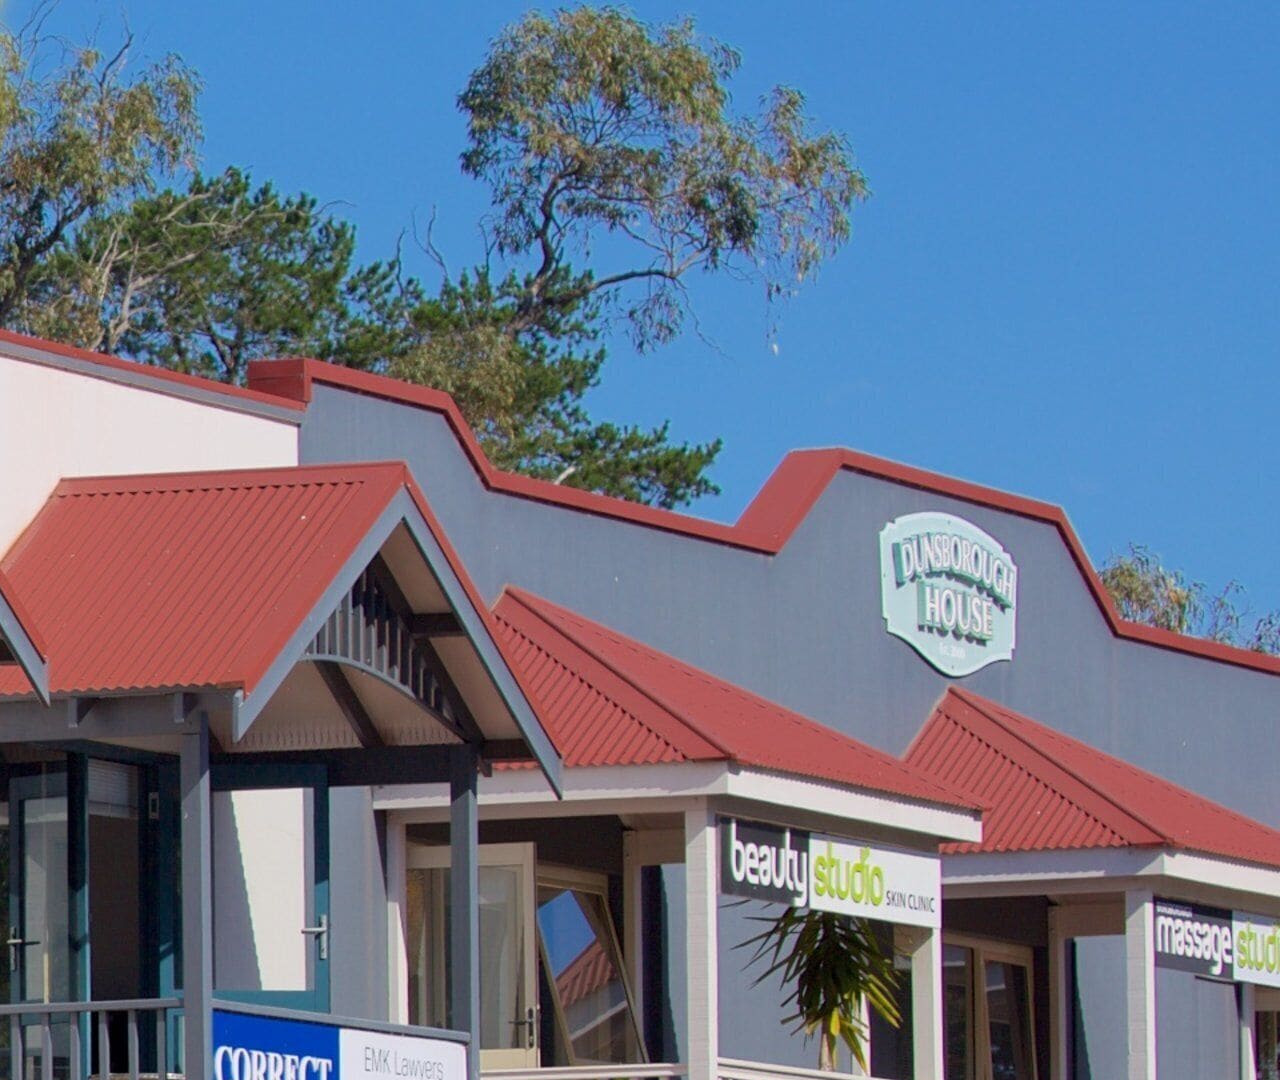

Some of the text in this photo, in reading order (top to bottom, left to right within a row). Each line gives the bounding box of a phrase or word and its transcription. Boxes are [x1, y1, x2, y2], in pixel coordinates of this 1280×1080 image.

[901, 532, 1014, 608] DUNSBOROUGH
[924, 585, 993, 637] HOUSE
[730, 818, 935, 914] beauty studio SKIN CLINIC
[1156, 914, 1280, 976] massage stud
[364, 1046, 391, 1075] EMK
